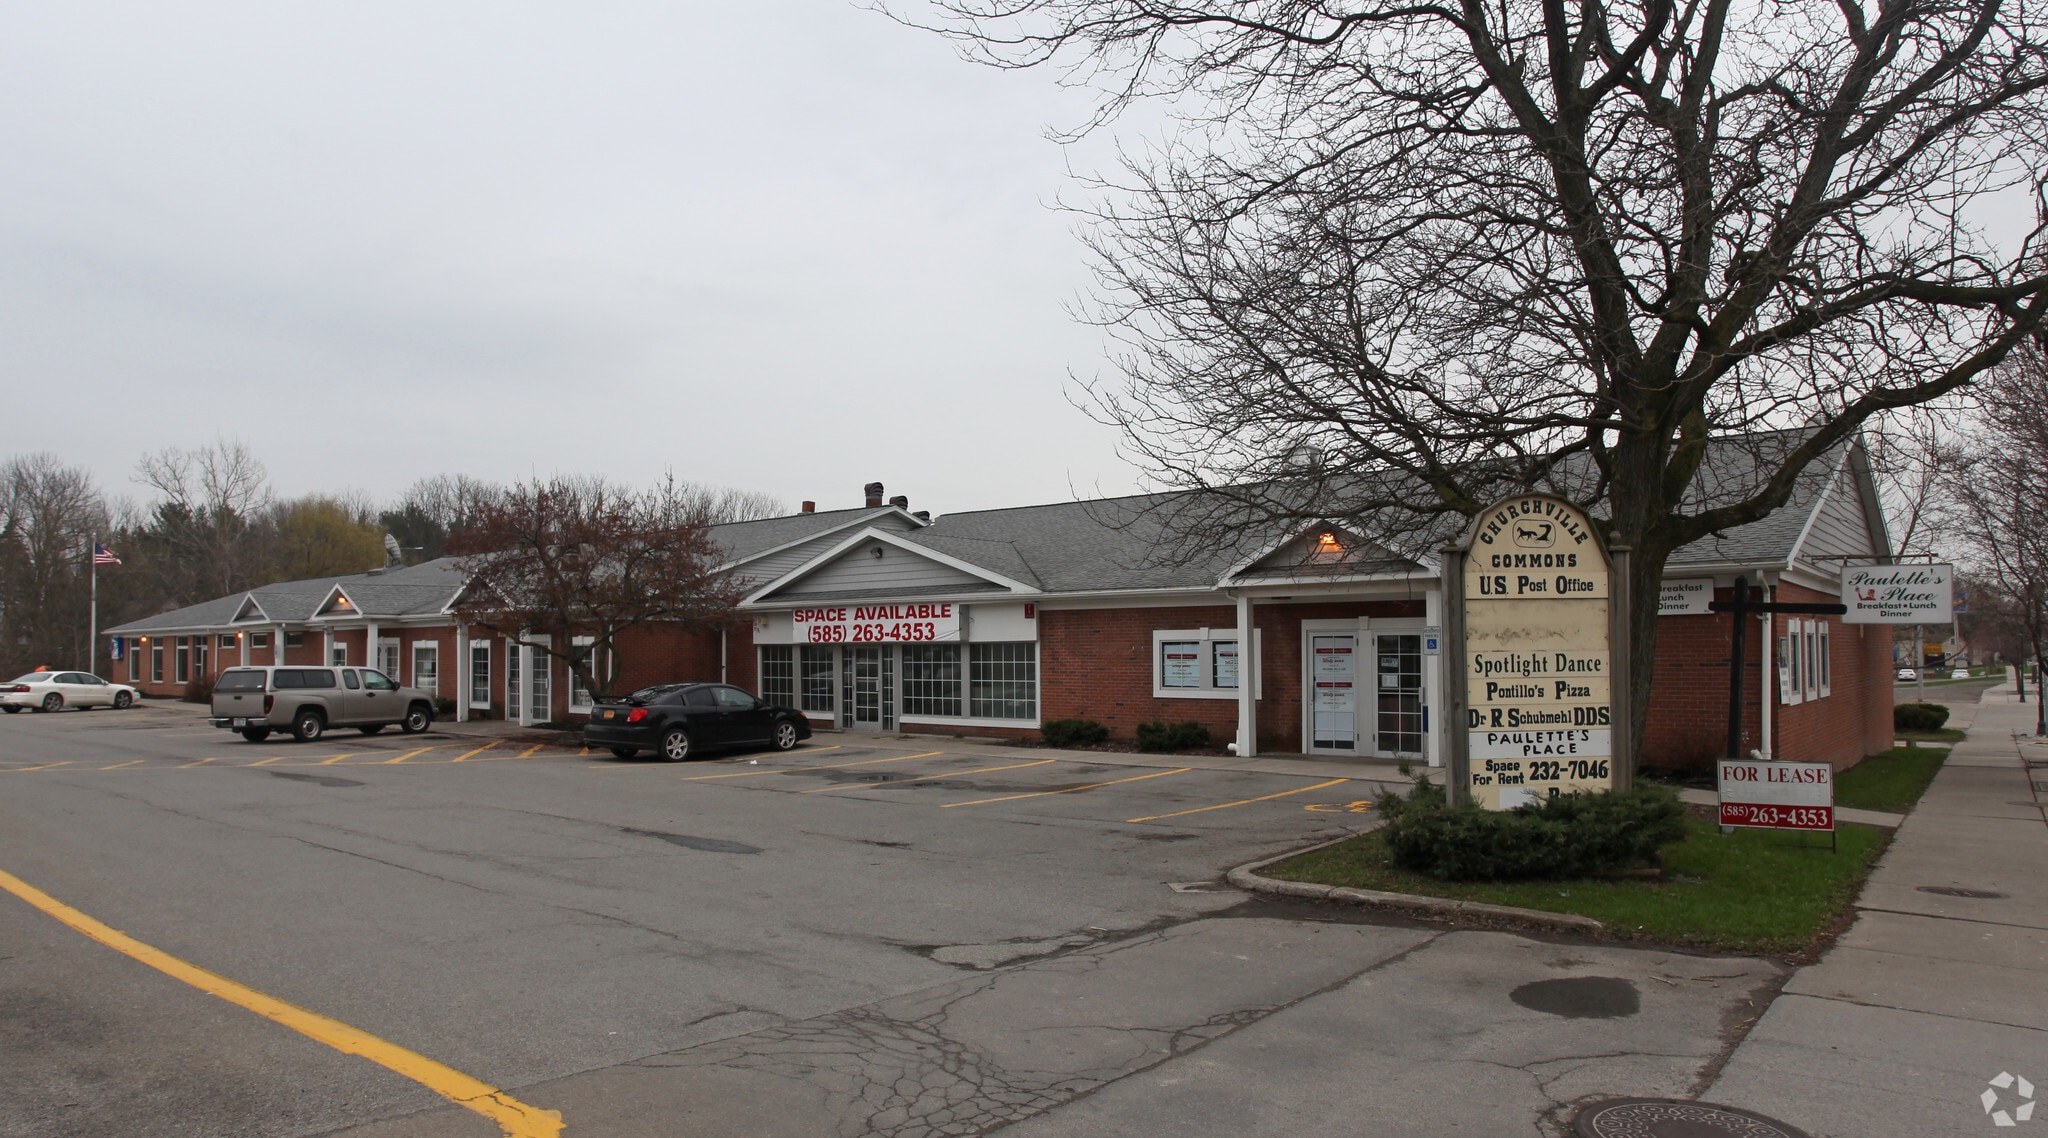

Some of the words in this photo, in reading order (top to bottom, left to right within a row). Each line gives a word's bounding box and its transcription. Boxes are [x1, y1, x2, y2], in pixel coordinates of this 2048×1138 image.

[1480, 500, 1590, 545] CHURCHVILLE
[1491, 553, 1577, 568] COMMONS
[1480, 575, 1509, 595] U.S.
[1518, 575, 1548, 595] Post
[1555, 575, 1594, 595] Office
[1848, 568, 1946, 586] Paulette's
[1881, 586, 1938, 602] Place
[794, 608, 847, 623] SPACE
[853, 603, 951, 621] AVAILABLE
[1857, 602, 1902, 610] Breakfast
[807, 625, 847, 643] (585)
[852, 622, 936, 642] 263-4353
[1474, 653, 1548, 677] Spotlight
[1555, 653, 1601, 672] Dance
[1486, 682, 1545, 701] Pontillo's
[1555, 681, 1591, 700] Pizza
[1508, 708, 1572, 728] Schubmehl
[1487, 730, 1590, 746] PAULETTE'S
[1523, 743, 1577, 756] PLACE
[1473, 774, 1493, 785] For
[1498, 772, 1524, 785] Rent
[1485, 759, 1520, 772] Space
[1529, 760, 1609, 780] 232-7046
[1723, 766, 1758, 782] FOR
[1767, 767, 1828, 784] LEASE
[1722, 805, 1749, 817] (585)
[1749, 807, 1828, 826] 263-4353
